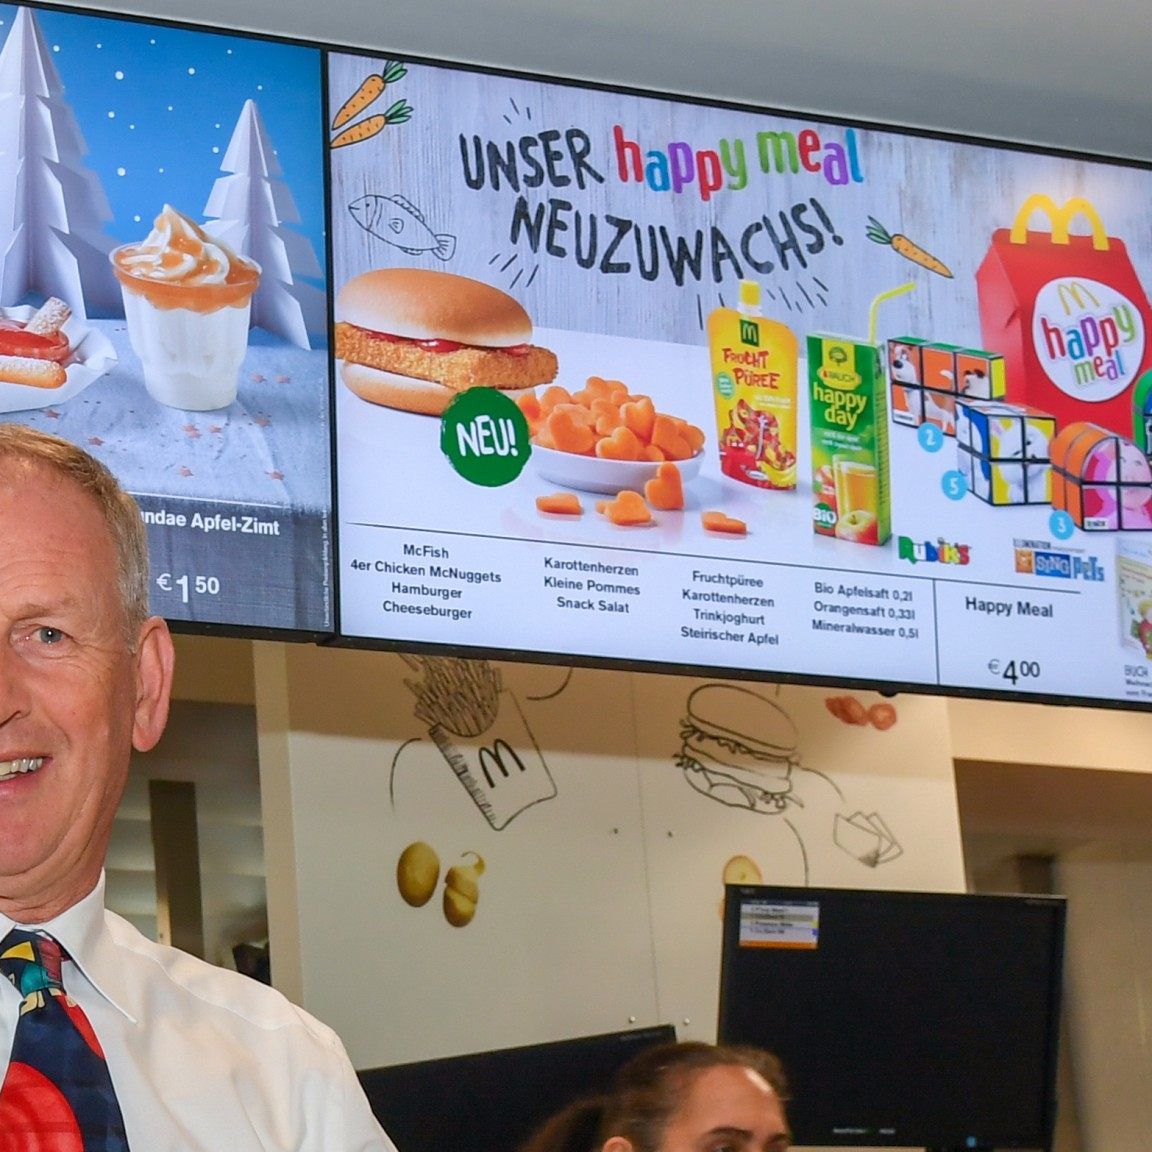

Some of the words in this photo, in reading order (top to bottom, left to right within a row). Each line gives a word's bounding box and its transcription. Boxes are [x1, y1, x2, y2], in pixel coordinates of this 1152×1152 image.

[458, 127, 605, 192] UNSER
[613, 125, 746, 201] happy
[757, 128, 863, 186] meal
[510, 195, 845, 287] NEUZUWACHS!
[1041, 304, 1136, 360] happy
[1074, 350, 1125, 385] meal
[813, 382, 868, 414] happy
[824, 406, 859, 431] day
[456, 413, 518, 457] NEU!
[924, 430, 936, 445] 2
[949, 478, 960, 494] 5
[191, 513, 280, 535] Apfel-Zimt
[1057, 517, 1066, 531] 3
[403, 543, 449, 560] McFish
[350, 559, 371, 572] 4er
[374, 561, 426, 578] Chicken
[429, 565, 502, 584] McNuggets
[544, 556, 639, 577] Karottenherzen
[544, 576, 584, 592] Kleine
[587, 580, 640, 597] Pommes
[692, 570, 764, 590] Fruchtpüree
[391, 581, 463, 600] Hamburger
[681, 588, 775, 608] Karottenherzen
[814, 581, 834, 595] Bio
[837, 583, 890, 601] Apfelsaft
[382, 600, 473, 621] Cheeseburger
[556, 596, 595, 611] Snack
[598, 600, 630, 614] Salat
[813, 601, 886, 621] Orangensaft
[965, 596, 1013, 618] Happy
[1017, 599, 1054, 618] Meal
[693, 608, 765, 627] Trinkjoghurt
[680, 626, 745, 643] Steirischer
[747, 630, 780, 646] Apfel
[812, 619, 895, 638] Mineralwasser
